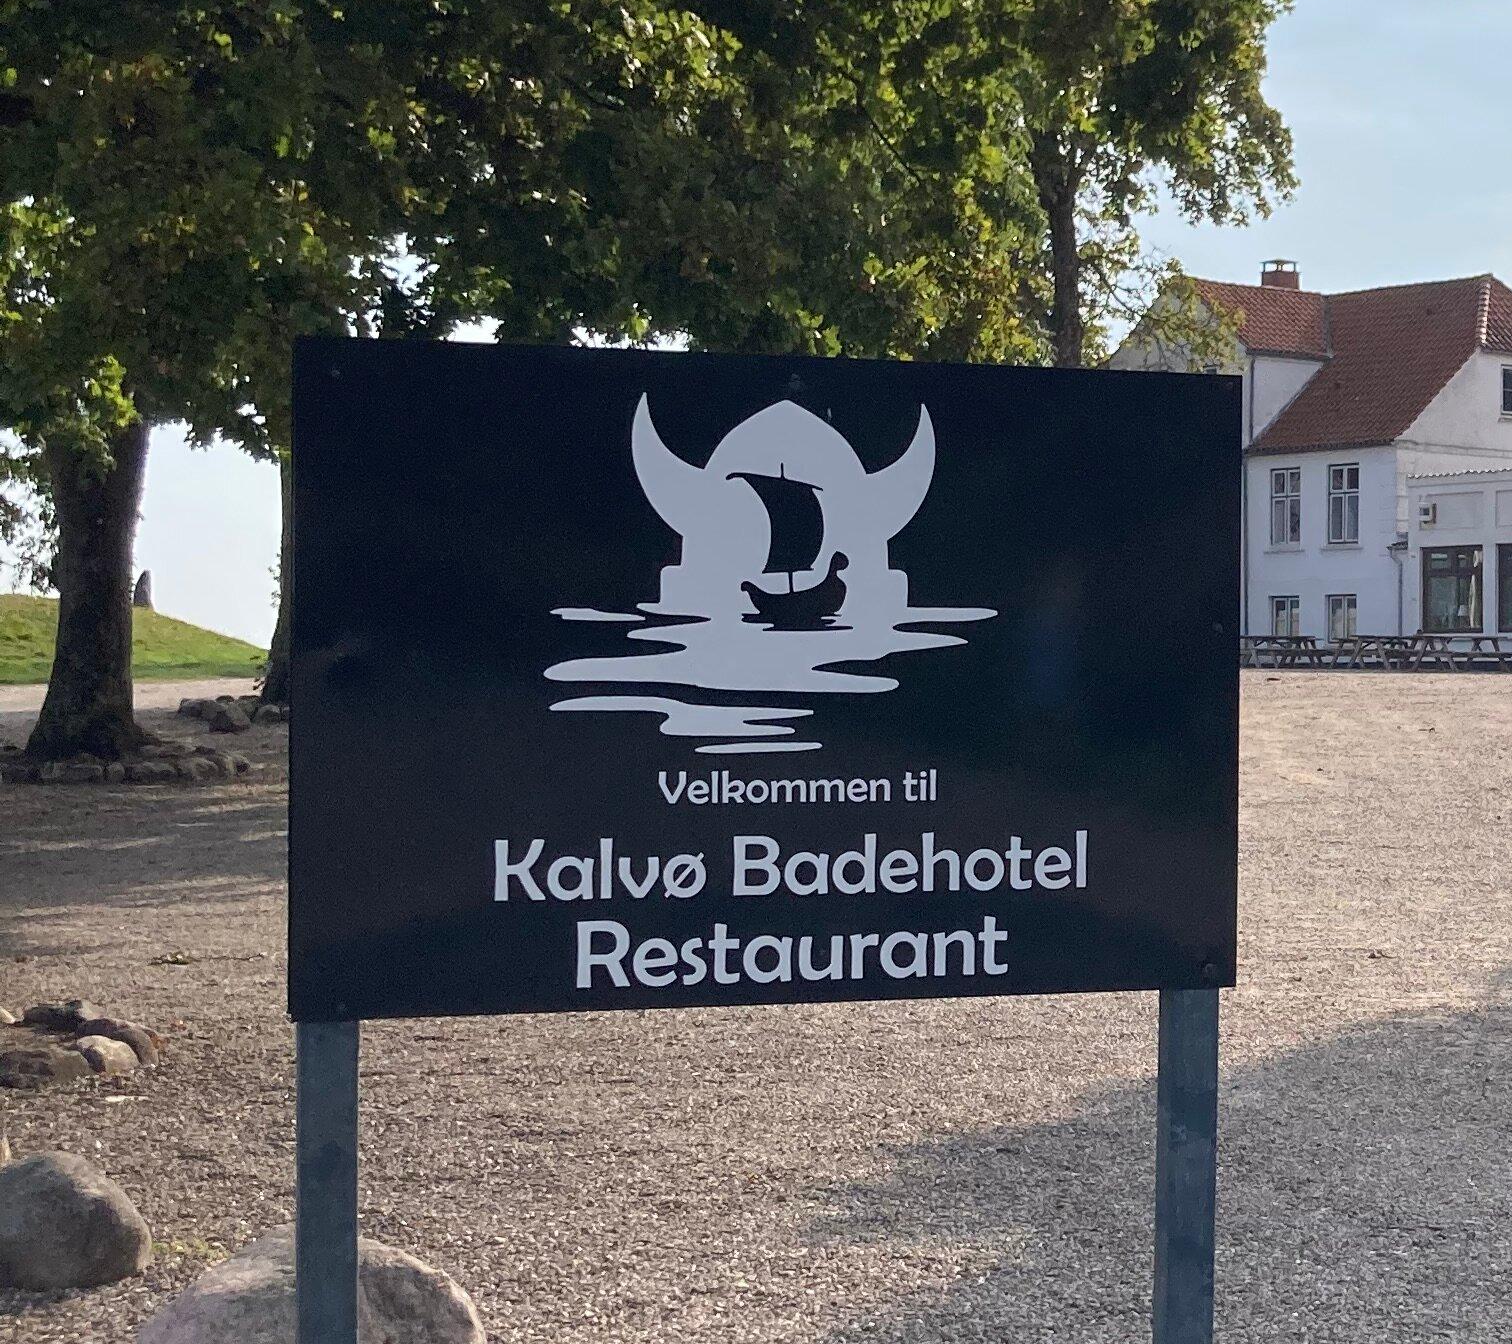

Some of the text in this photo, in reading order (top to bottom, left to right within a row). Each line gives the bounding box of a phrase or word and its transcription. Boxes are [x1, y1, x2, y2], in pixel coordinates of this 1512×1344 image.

[658, 768, 937, 805] Velkommen til
[493, 829, 1088, 902] Kalvø Badehotel
[576, 915, 1009, 988] Restaurant
